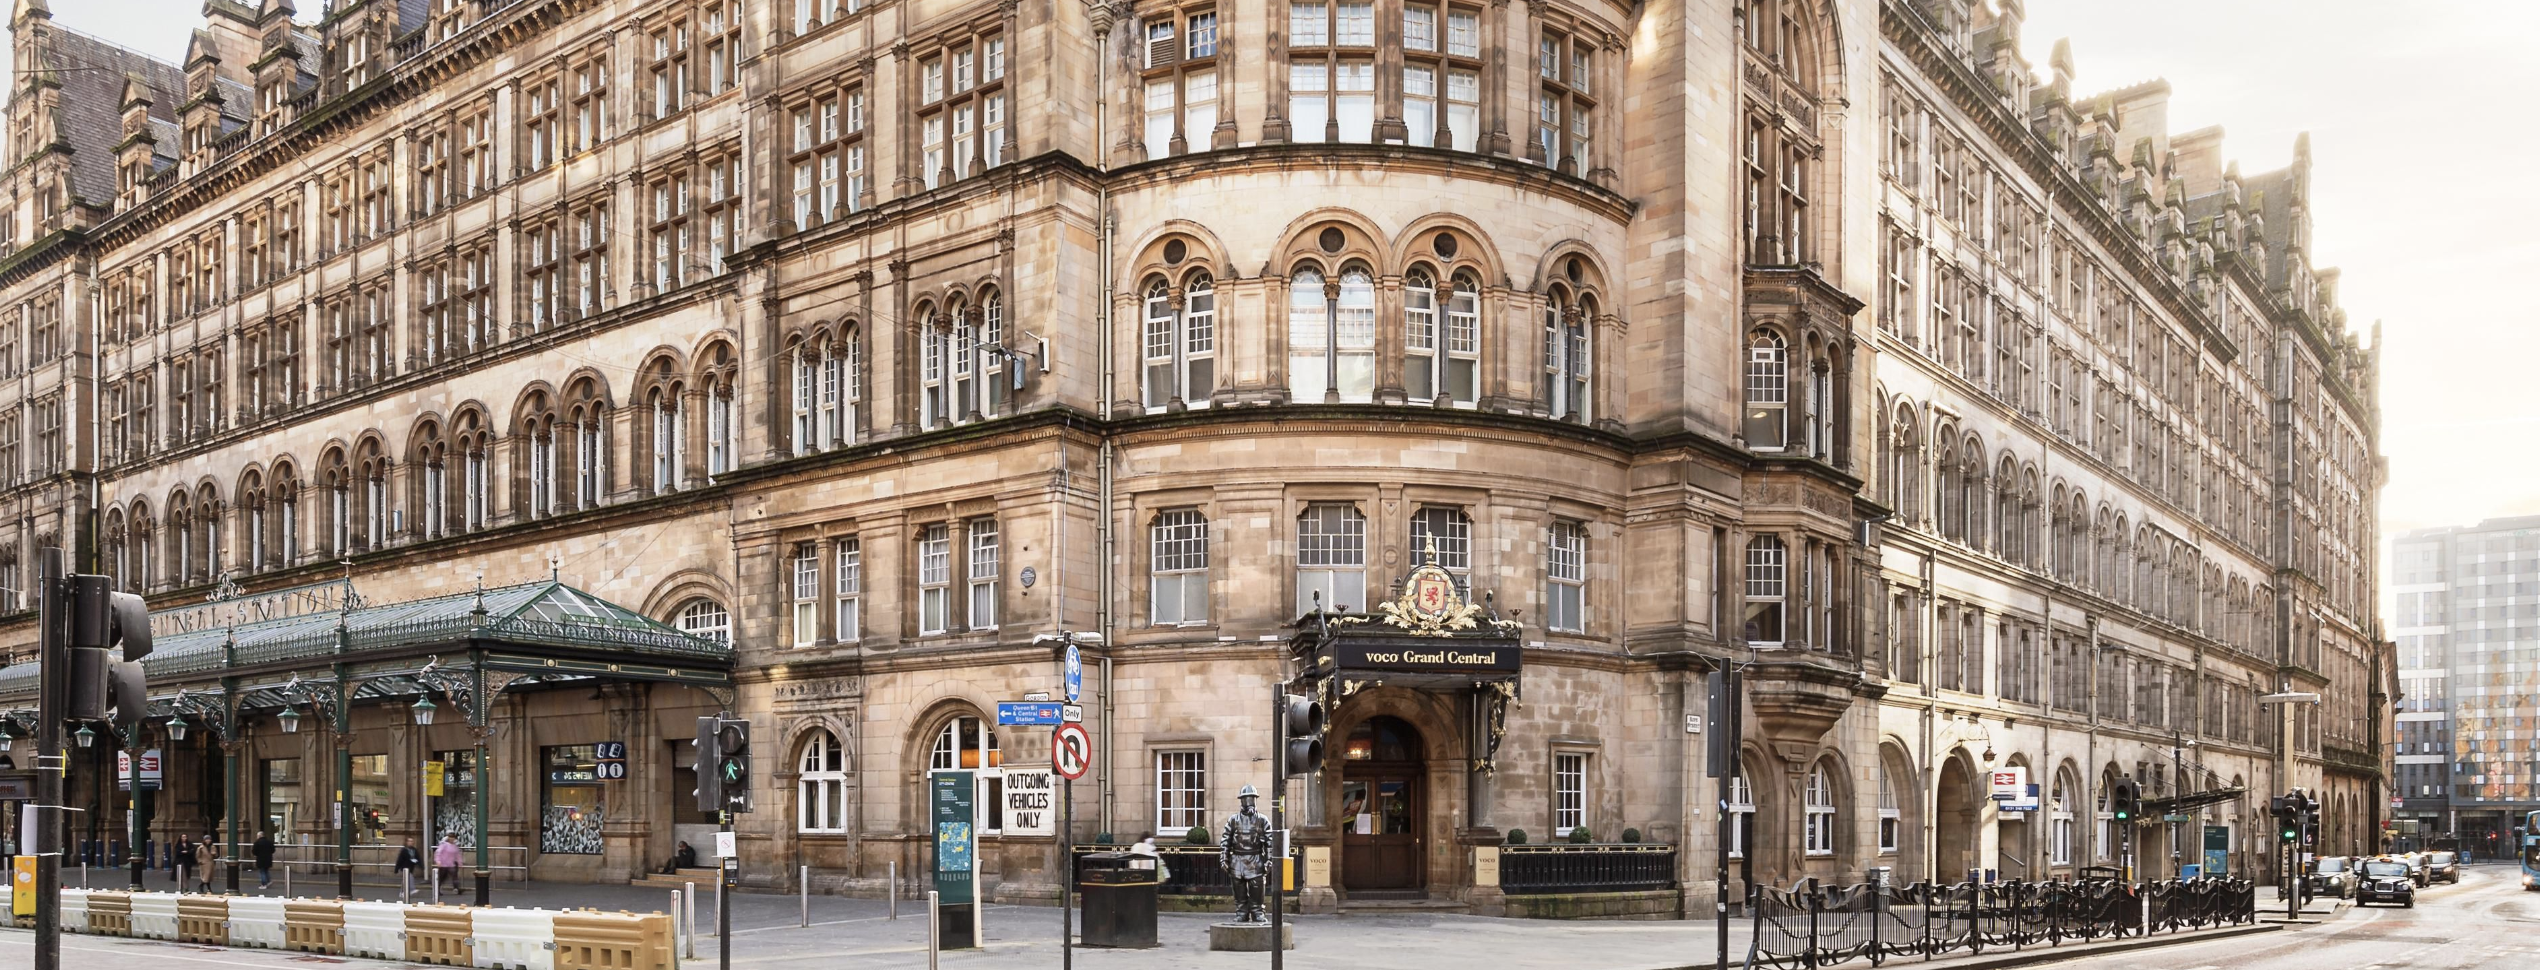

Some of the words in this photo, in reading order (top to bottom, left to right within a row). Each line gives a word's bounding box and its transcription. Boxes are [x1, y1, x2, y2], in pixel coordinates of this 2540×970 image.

[1366, 653, 1398, 663] voco
[1403, 651, 1444, 664] Grand
[1447, 651, 1496, 665] Central
[1065, 709, 1079, 718] Only
[1008, 773, 1050, 789] OUTGOING
[1008, 792, 1049, 809] VEHICLES
[1016, 812, 1041, 829] ONLY
